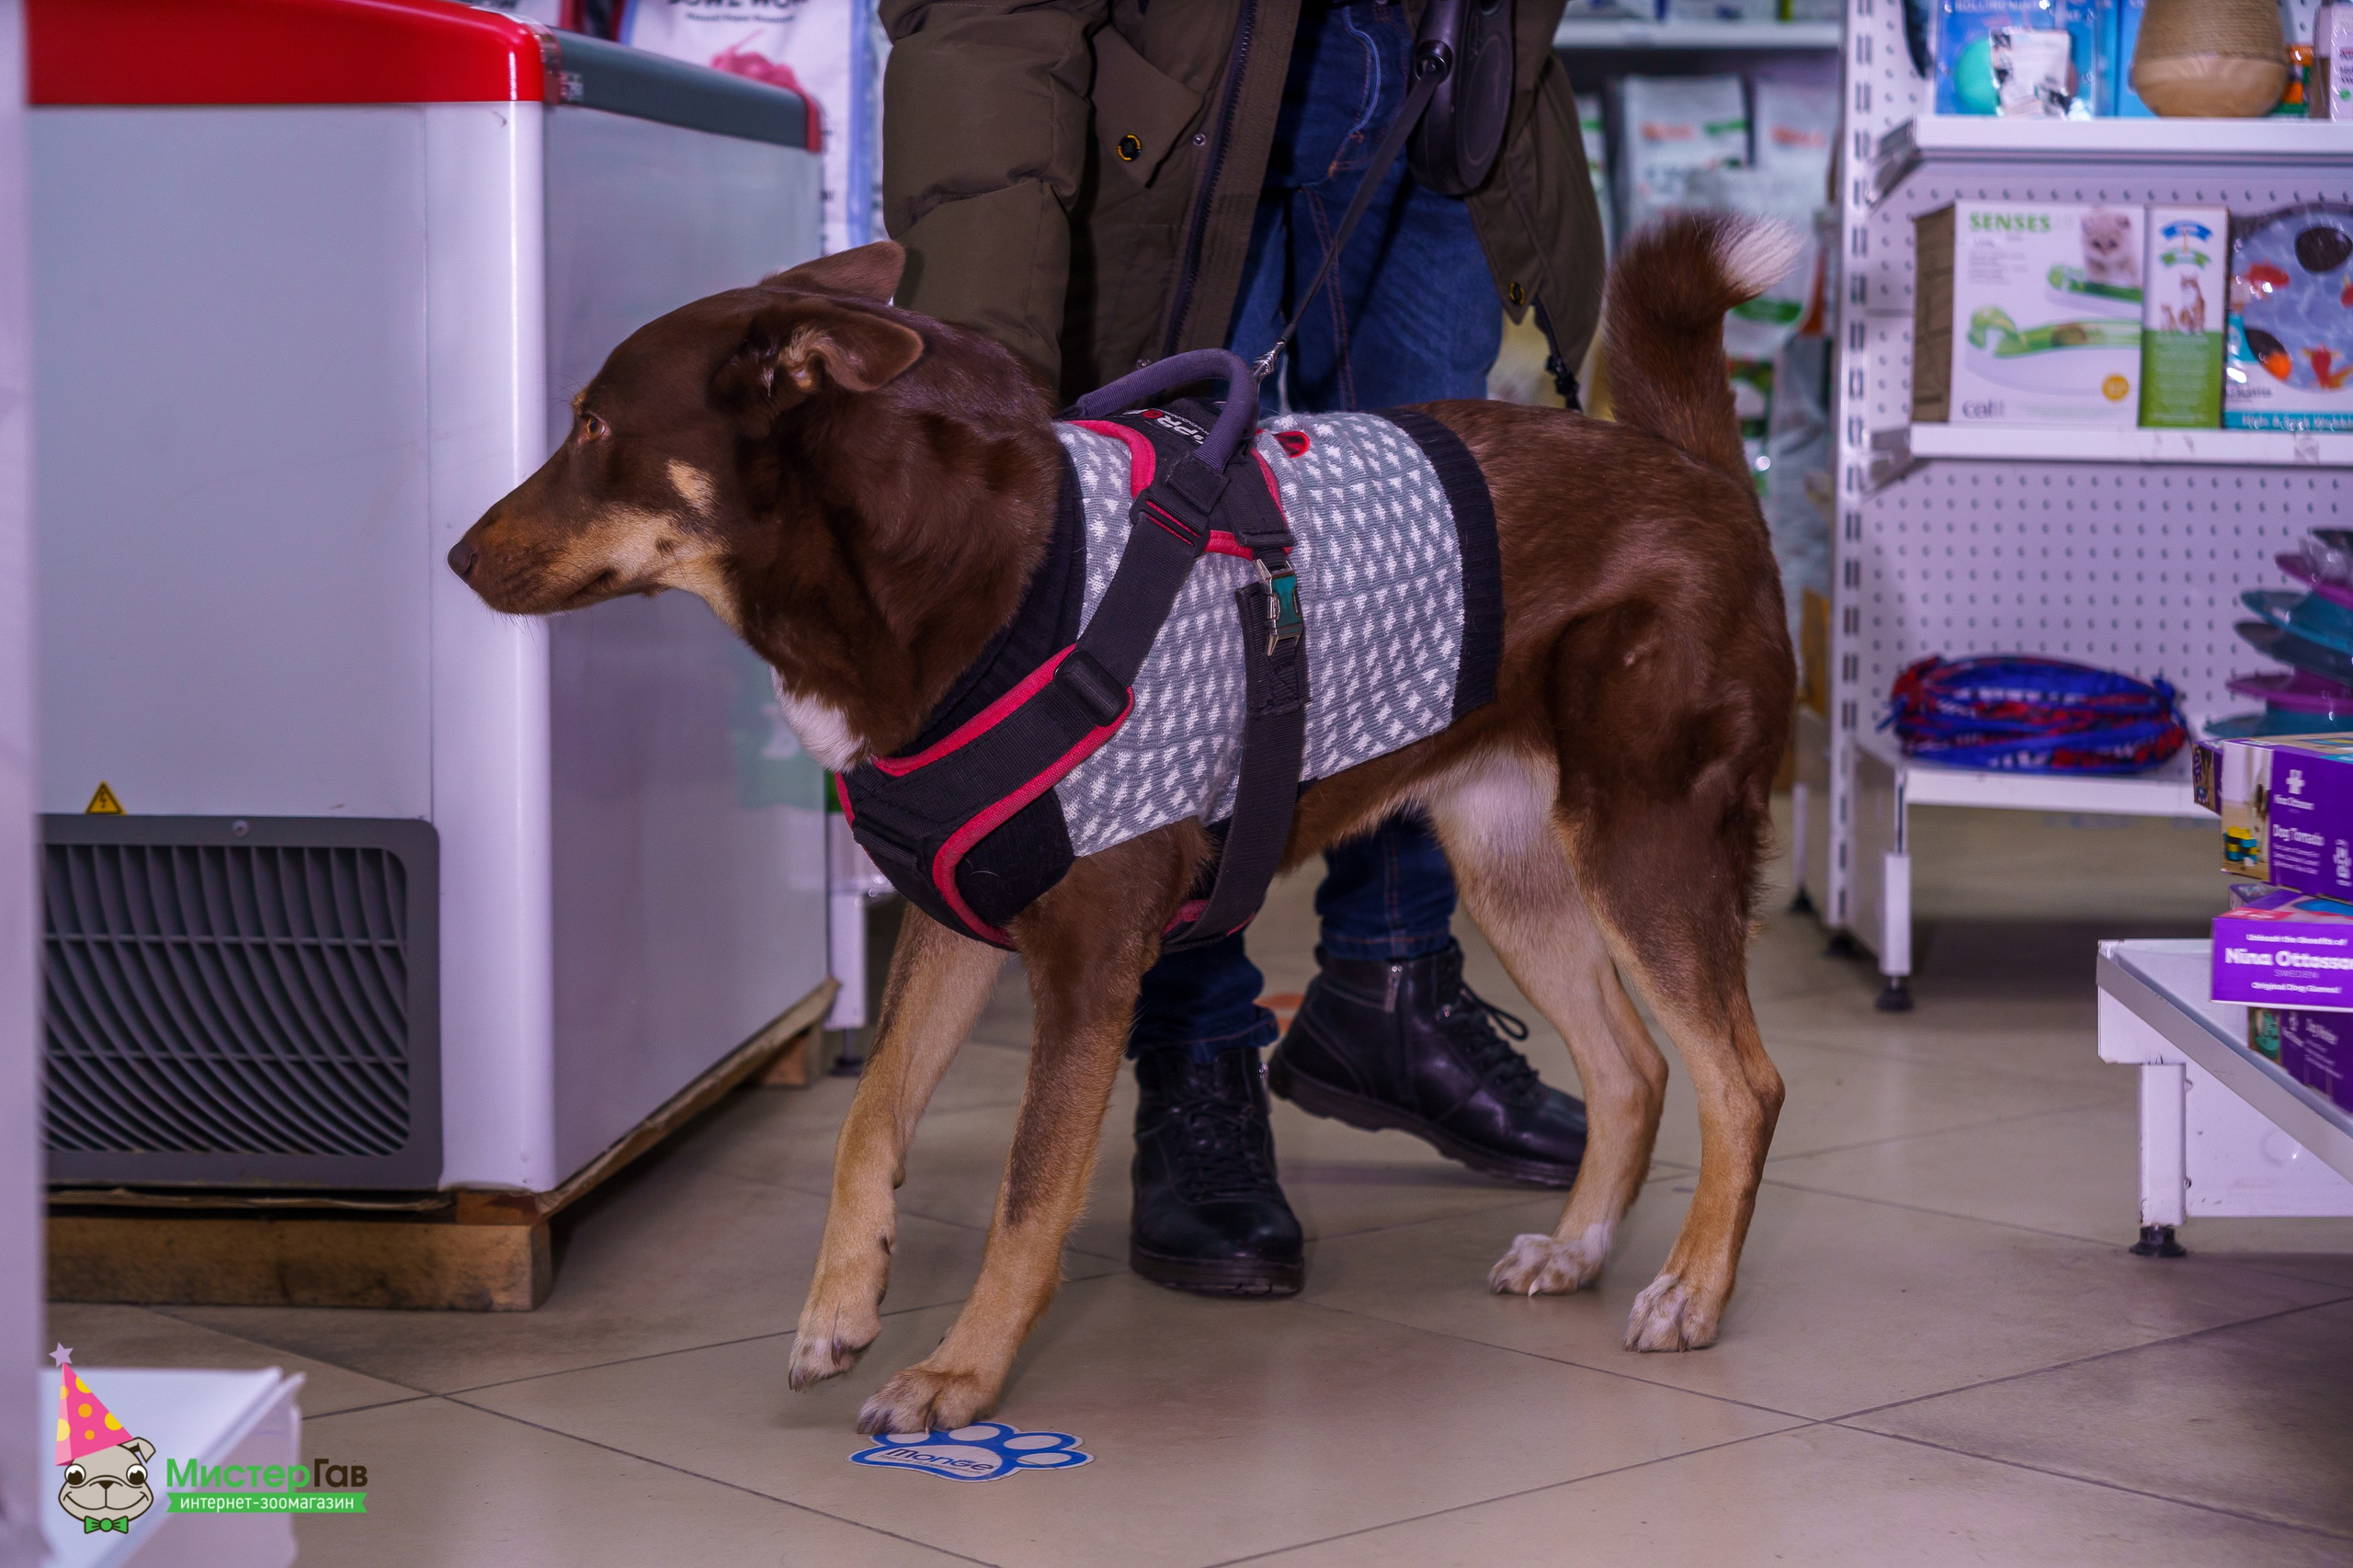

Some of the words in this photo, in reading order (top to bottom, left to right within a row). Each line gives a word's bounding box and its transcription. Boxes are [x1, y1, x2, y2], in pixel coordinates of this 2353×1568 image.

[1970, 211, 2052, 232] SENSES
[2245, 934, 2280, 943] Unleash
[2281, 936, 2296, 944] the
[2298, 937, 2333, 946] Benefits
[2335, 938, 2348, 947] of
[2225, 948, 2274, 966] Nina
[2274, 970, 2319, 979] SWEDEN
[2251, 982, 2285, 992] Original
[2287, 984, 2306, 994] Dog
